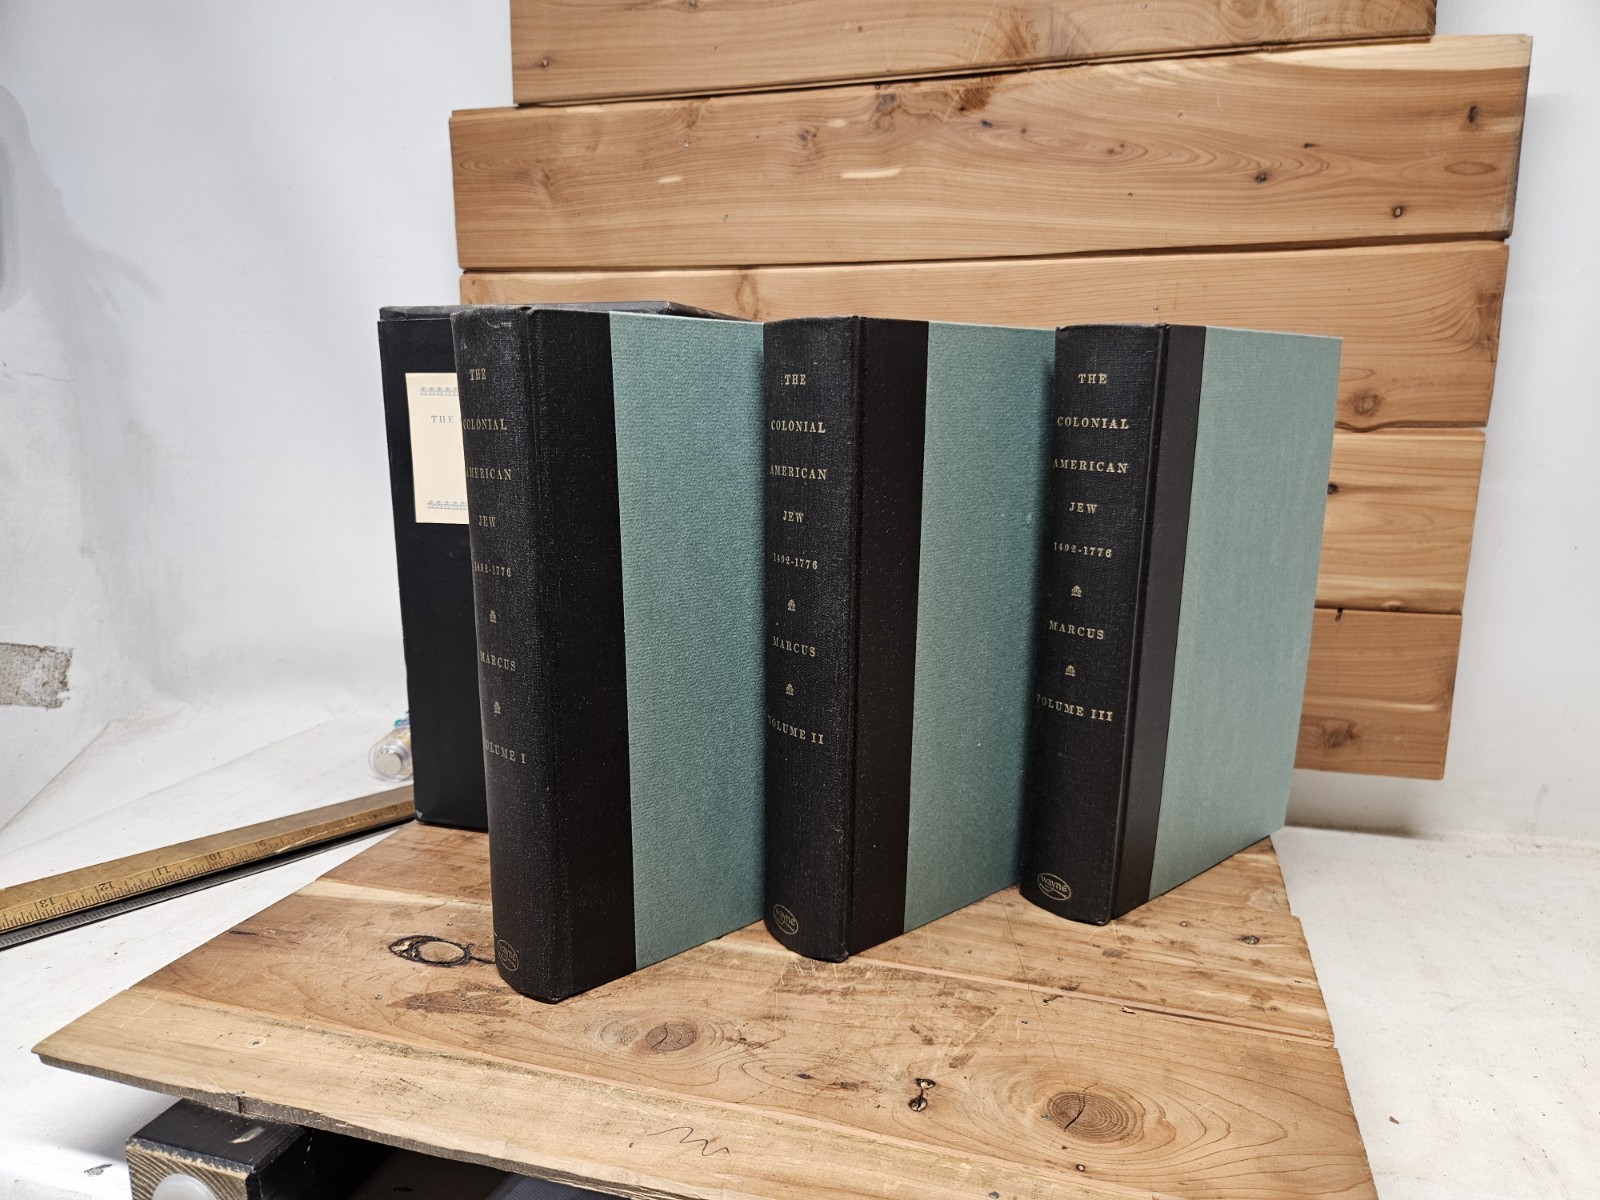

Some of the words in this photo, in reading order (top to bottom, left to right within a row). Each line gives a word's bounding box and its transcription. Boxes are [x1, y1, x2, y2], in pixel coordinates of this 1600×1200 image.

[468, 367, 487, 381] THE
[784, 373, 807, 386] THE
[1077, 372, 1108, 385] THE
[430, 414, 455, 424] THE
[1056, 416, 1130, 430] COLONIAL
[770, 419, 826, 434] COLONIAL
[769, 464, 828, 481] AMERICAN
[1052, 458, 1130, 474] AMERICAN
[1069, 501, 1098, 514] JEW
[478, 514, 496, 528] JEW
[782, 510, 805, 524] JEW
[1053, 541, 1113, 559] 1492-1776
[772, 552, 818, 571] 1492-1776
[1048, 620, 1105, 640] MARCUS
[772, 635, 817, 657] MARCUS
[479, 650, 517, 672] MARCUS
[1090, 708, 1114, 722] III
[811, 732, 825, 746] II
[520, 752, 527, 765] I
[39, 896, 57, 908] 13
[99, 880, 116, 893] 12
[155, 865, 171, 877] 11
